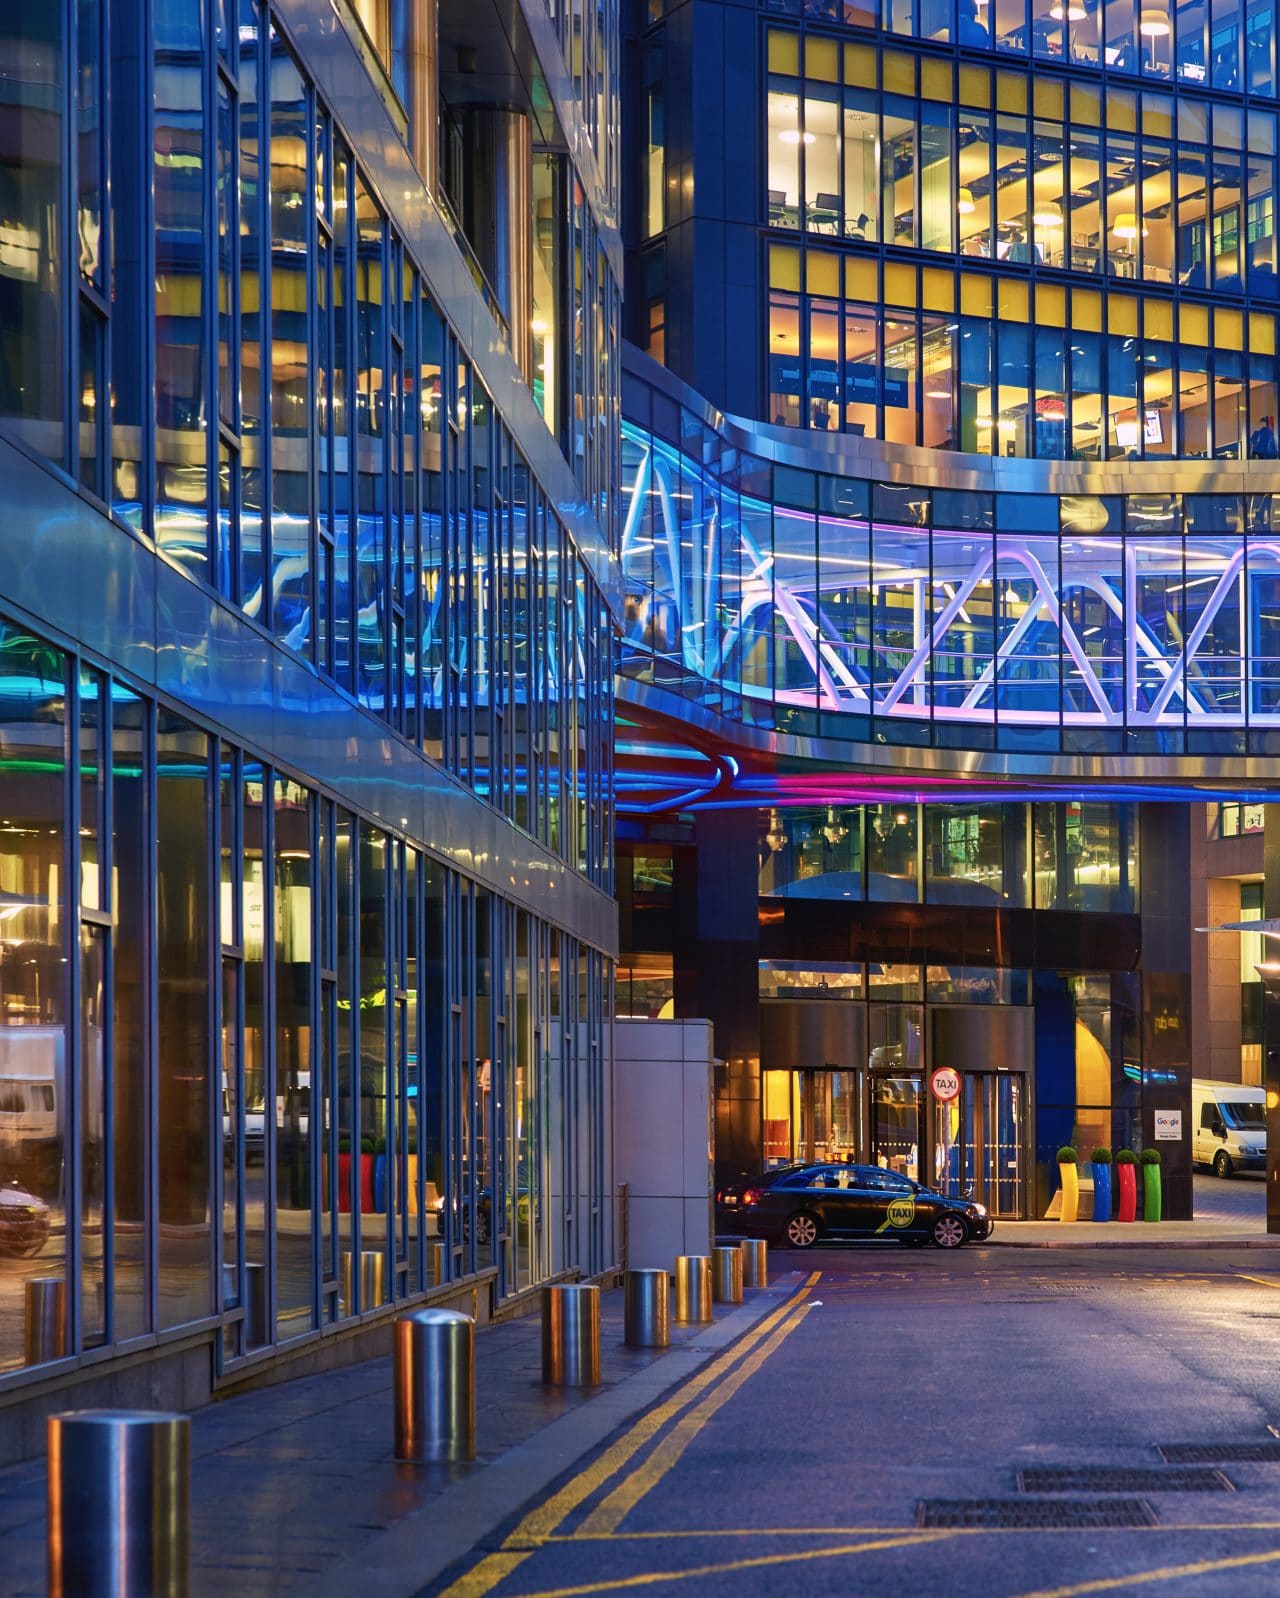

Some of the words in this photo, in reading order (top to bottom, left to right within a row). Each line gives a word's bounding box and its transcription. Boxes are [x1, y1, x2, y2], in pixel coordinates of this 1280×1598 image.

[936, 1079, 956, 1089] TAXI
[1158, 1117, 1179, 1127] Google
[891, 1208, 911, 1218] TAXI
